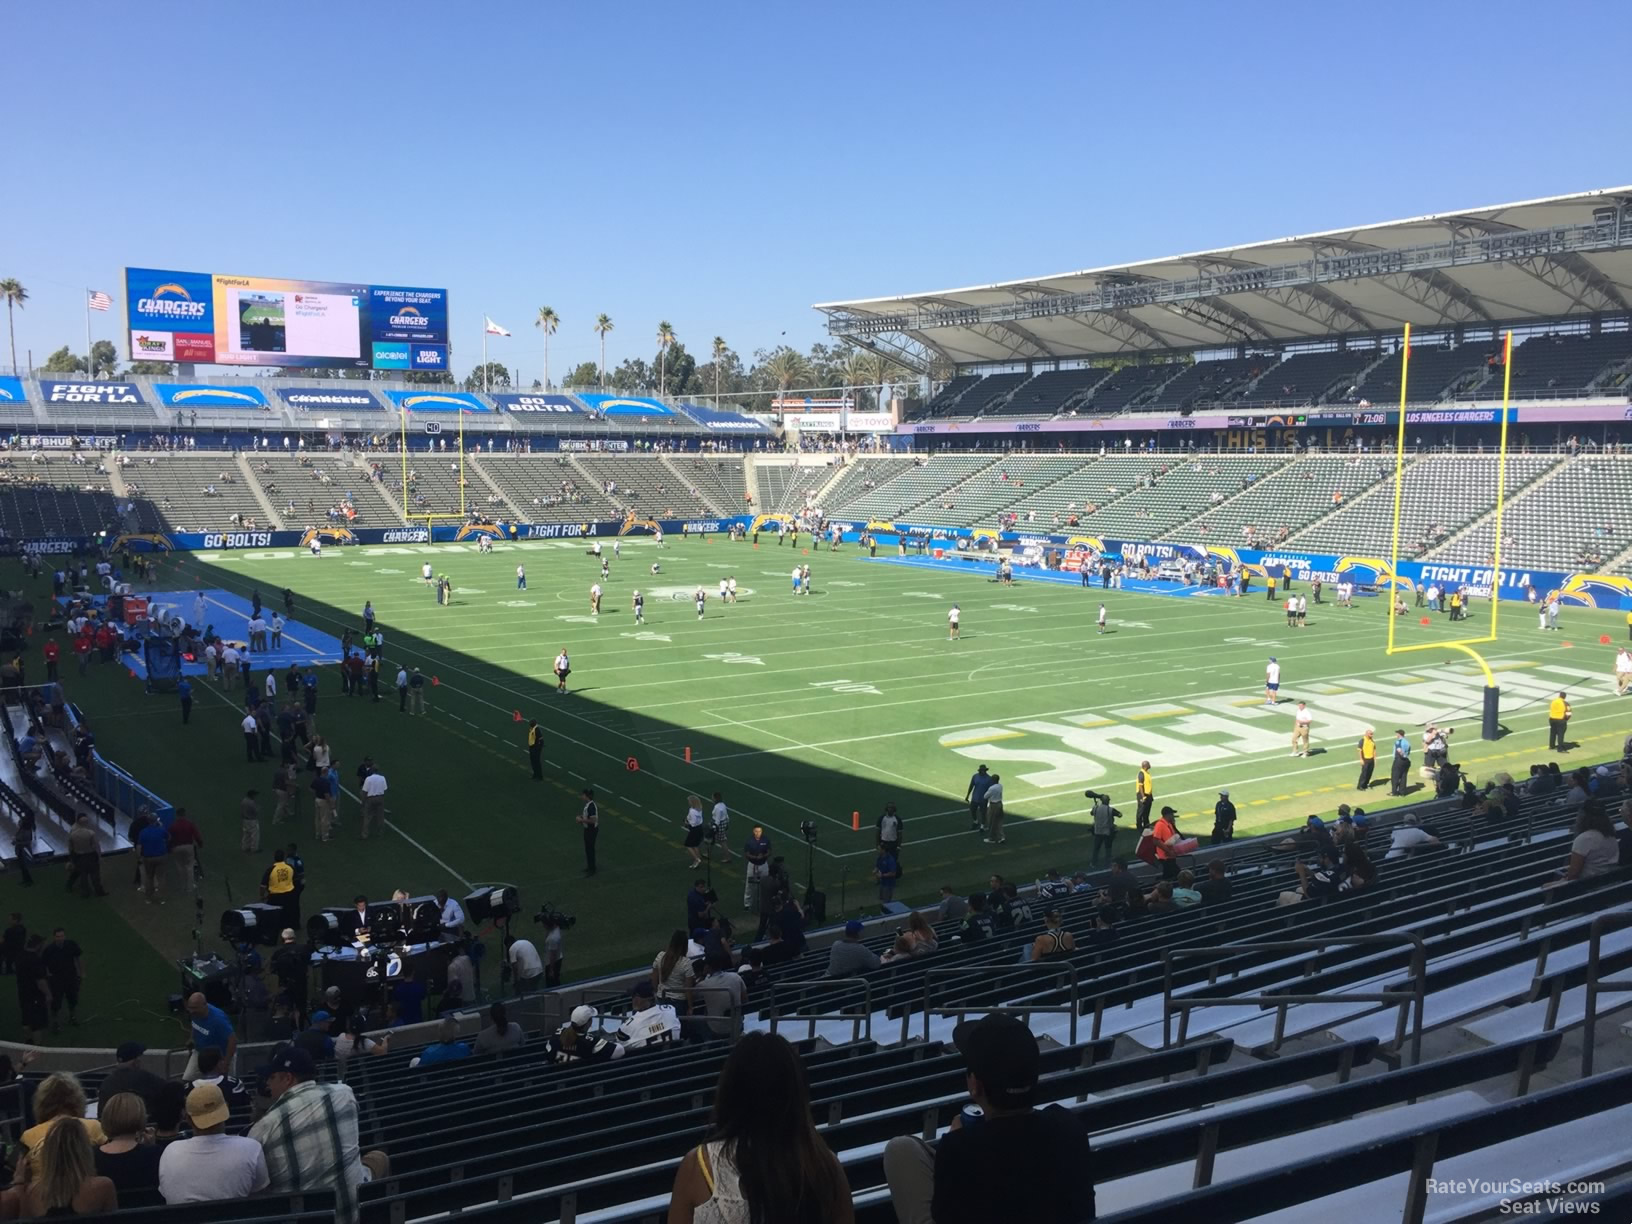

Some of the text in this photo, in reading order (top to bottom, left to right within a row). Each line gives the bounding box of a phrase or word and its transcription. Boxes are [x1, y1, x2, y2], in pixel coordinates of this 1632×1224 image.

[137, 298, 207, 316] CHARGERS
[389, 315, 429, 326] CHARGERS
[375, 351, 408, 360] alcatel
[416, 356, 442, 364] LIGHT
[52, 384, 127, 395] FIGHT
[50, 393, 138, 403] FOR LA
[518, 397, 546, 405] GO
[507, 403, 574, 412] BOLTS!
[1247, 416, 1254, 426] 0
[1287, 415, 1294, 425] 0
[1406, 410, 1495, 422] LOS ANGELES CHARGERS
[427, 422, 439, 432] 40
[864, 418, 893, 426] TOYOT
[1167, 419, 1196, 428] CHARGERS
[20, 437, 73, 446] SBHUB
[1214, 430, 1266, 448] THIS
[562, 524, 582, 536] FOR
[683, 522, 720, 533] HARGERS
[204, 533, 271, 547] GO BOLTS!
[383, 530, 428, 543] CHARGERS
[1121, 543, 1136, 555] GO
[1260, 556, 1312, 569] CHARGERS
[1298, 570, 1340, 583] GO BOLTS!
[1420, 565, 1471, 583] FIGHT
